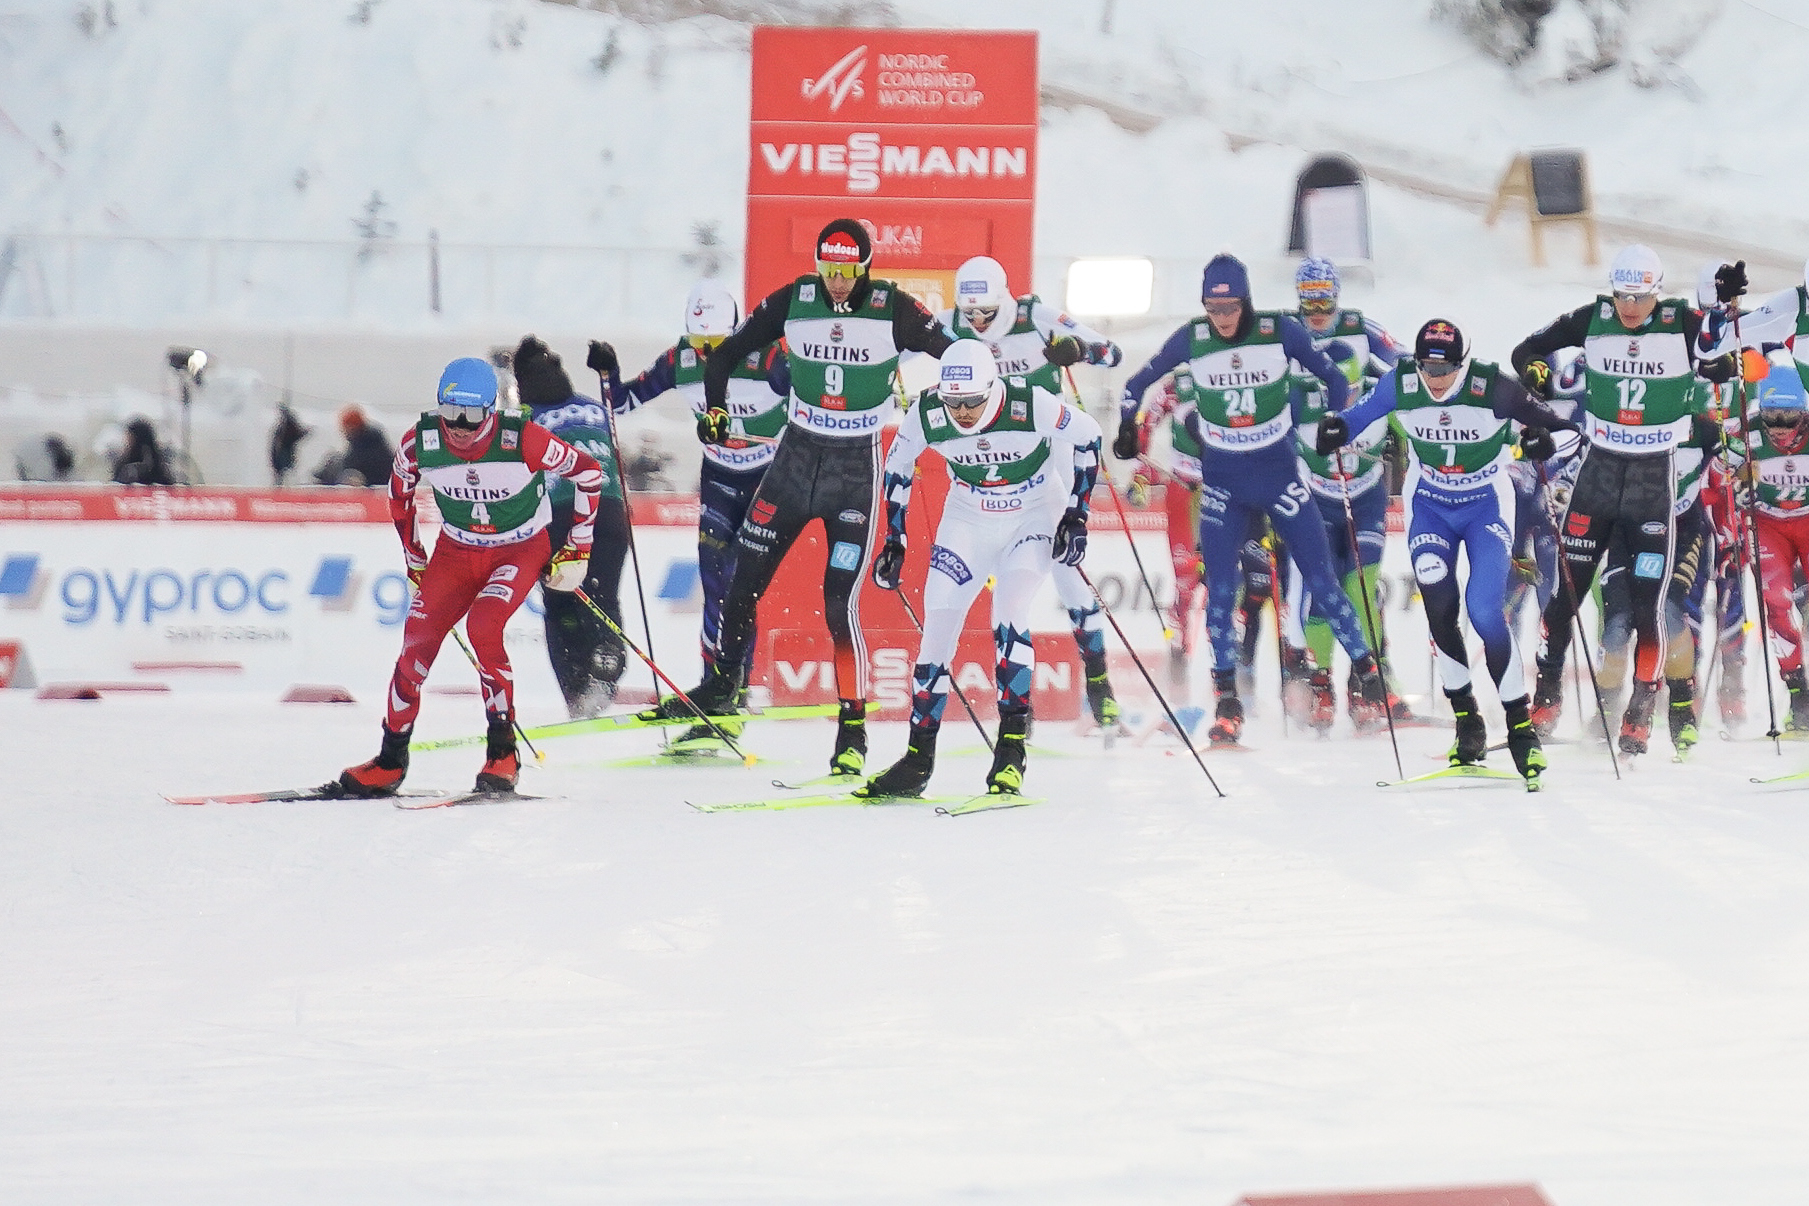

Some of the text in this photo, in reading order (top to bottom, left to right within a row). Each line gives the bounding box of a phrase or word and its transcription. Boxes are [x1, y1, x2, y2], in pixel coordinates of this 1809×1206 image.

[878, 54, 950, 70] NORDIC
[878, 72, 977, 89] COMBINED
[878, 90, 986, 108] WORLD CUP
[759, 132, 1029, 193] VIESSMANN
[802, 342, 870, 362] VELTINS
[1603, 357, 1665, 376] VELTINS
[824, 364, 845, 395] 9
[1208, 370, 1270, 385] VELTINS
[1222, 388, 1258, 418] 24
[1616, 378, 1647, 410] 12
[795, 400, 878, 431] Webasto
[1415, 426, 1480, 441] VELTINS
[1593, 419, 1673, 445] Webasto
[953, 451, 1022, 464] VELTINS
[1441, 445, 1458, 466] 7
[443, 486, 510, 500] VELTINS
[470, 502, 491, 525] 4
[985, 498, 1022, 510] BDO
[60, 569, 289, 625] gyproc
